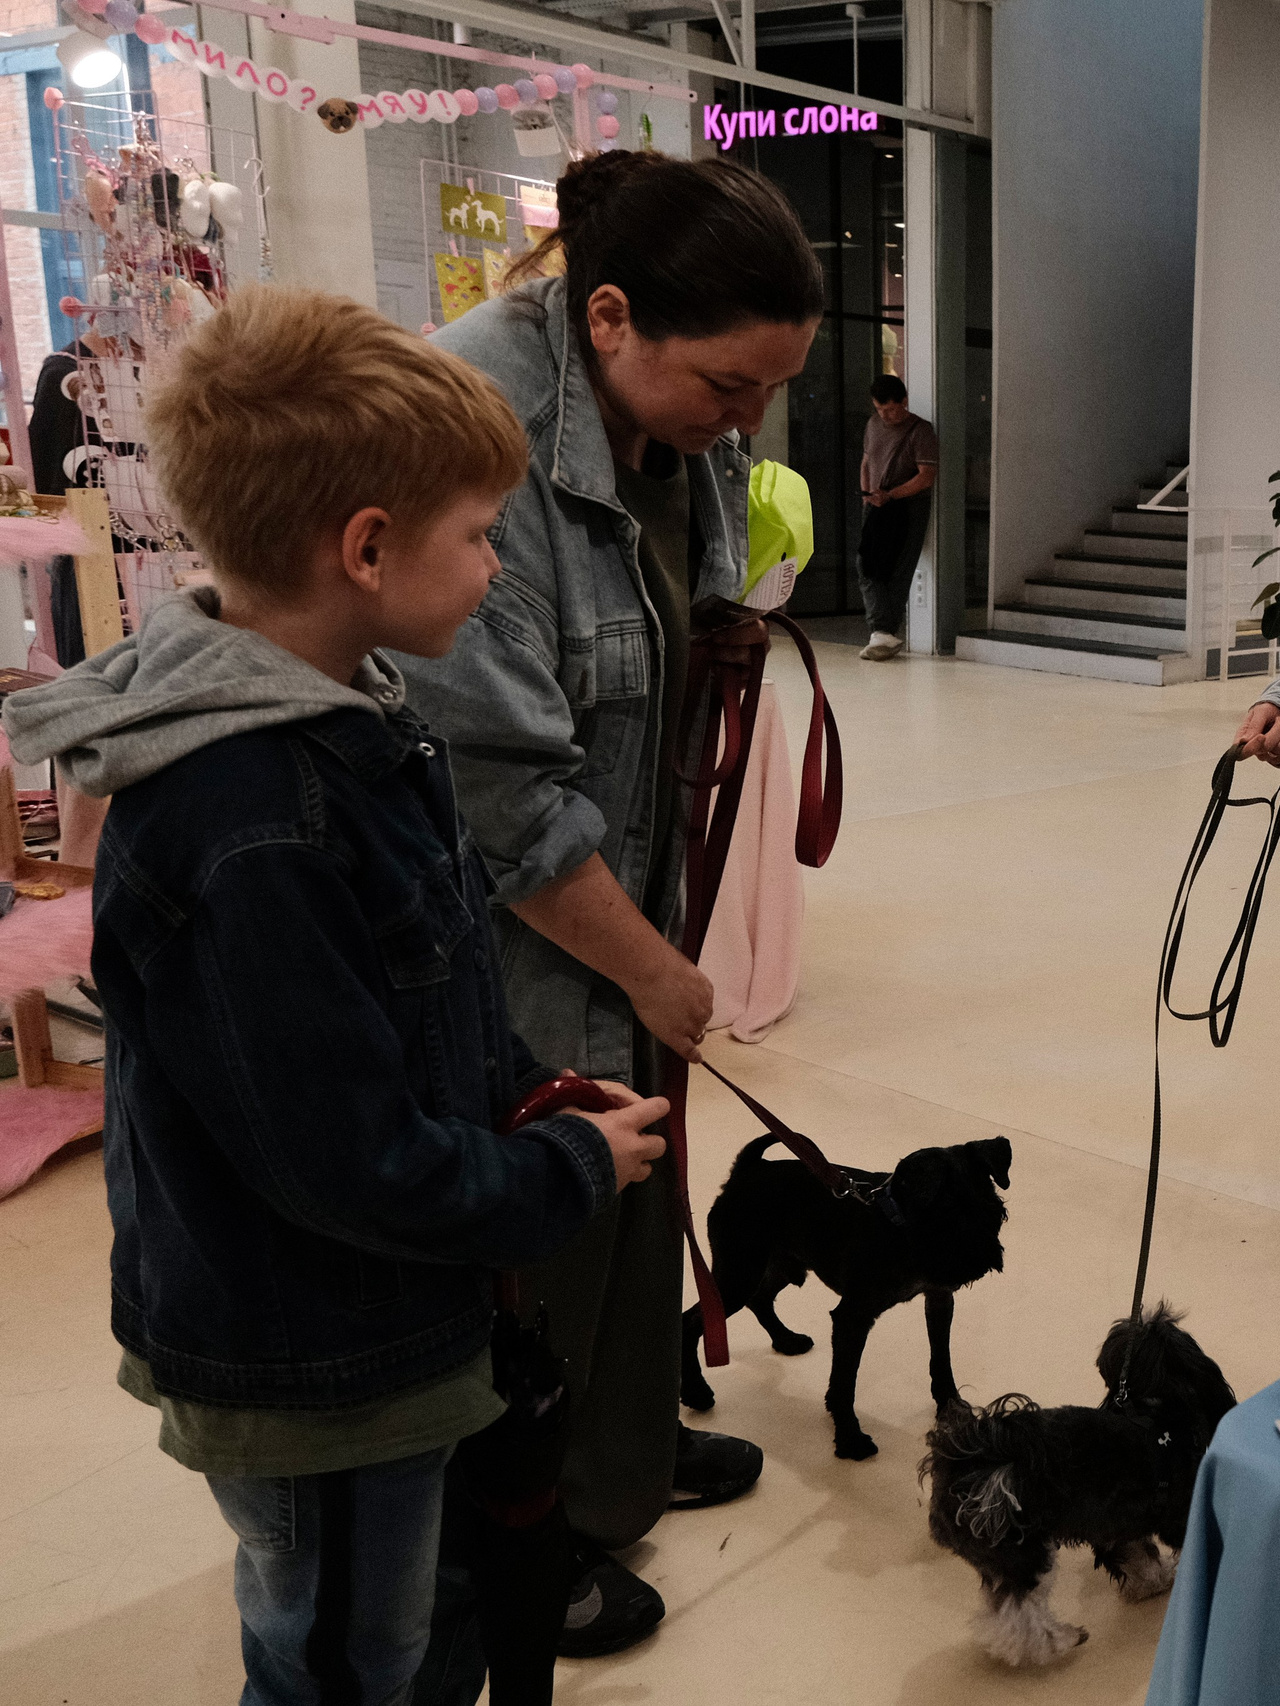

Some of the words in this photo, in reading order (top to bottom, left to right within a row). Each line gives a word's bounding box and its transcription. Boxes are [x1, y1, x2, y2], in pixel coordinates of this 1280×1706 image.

[356, 92, 452, 121] МЯУ!
[703, 104, 776, 150] Купи
[783, 105, 878, 135] слона
